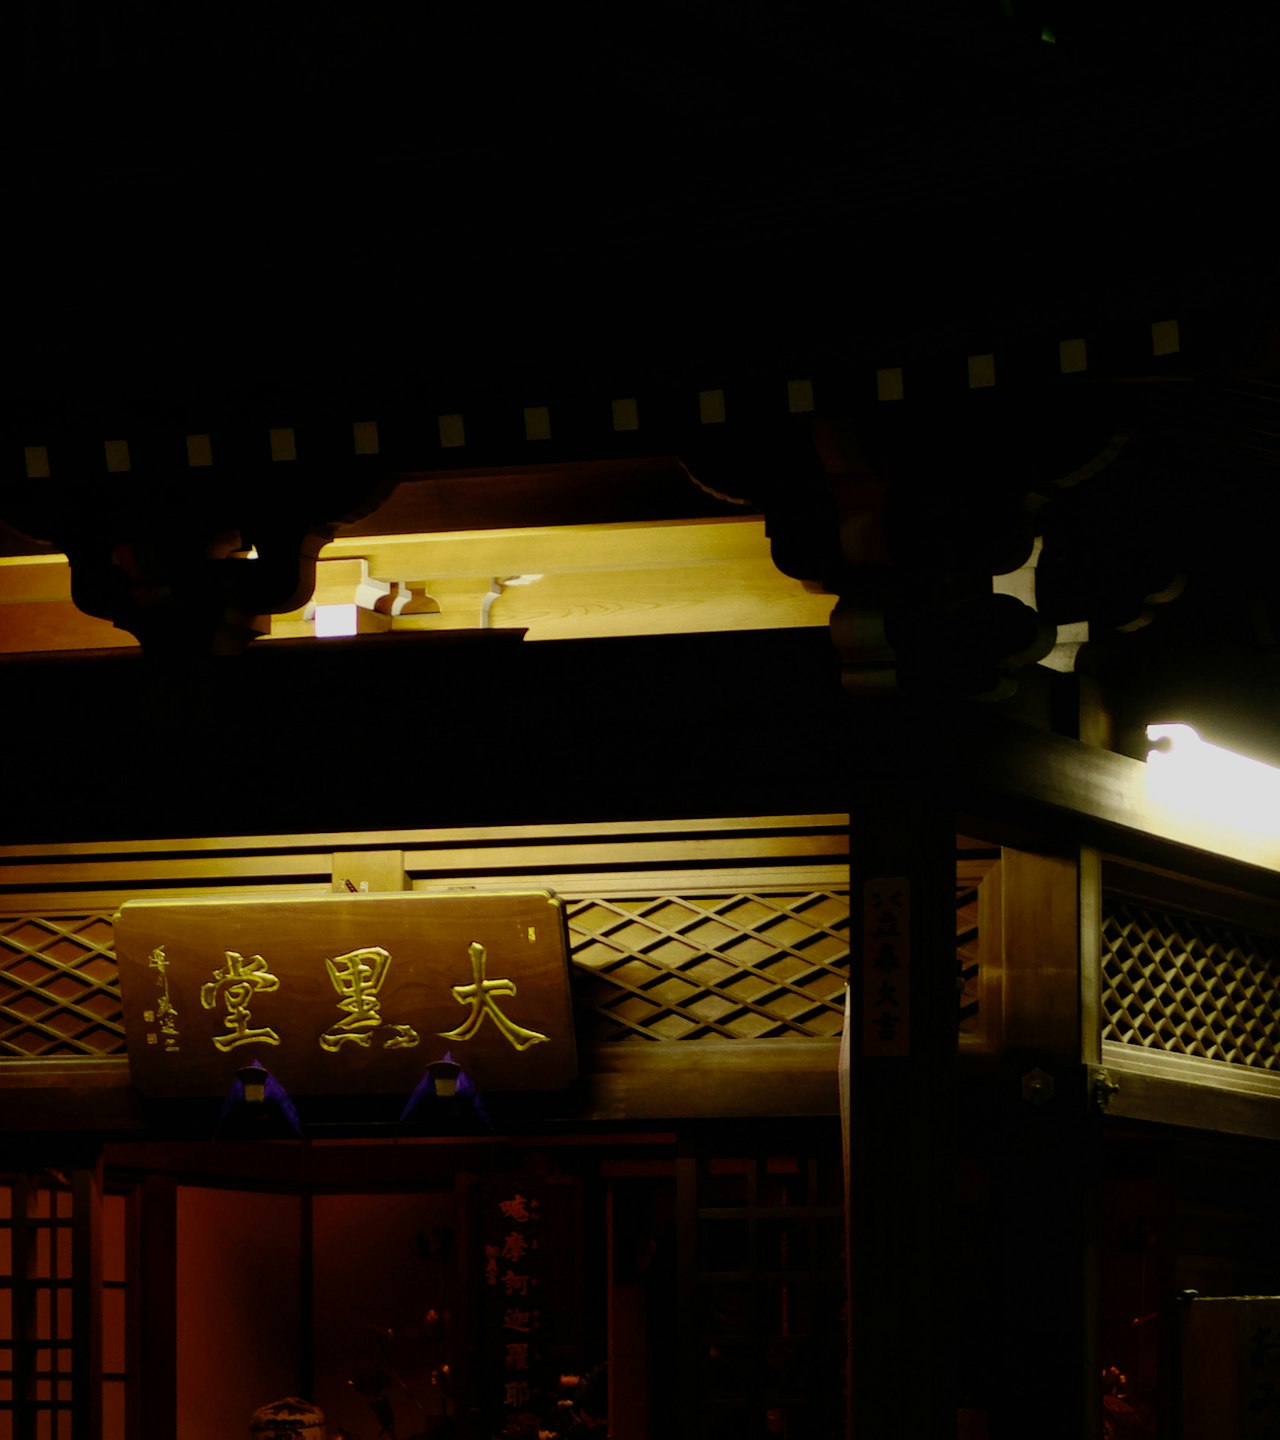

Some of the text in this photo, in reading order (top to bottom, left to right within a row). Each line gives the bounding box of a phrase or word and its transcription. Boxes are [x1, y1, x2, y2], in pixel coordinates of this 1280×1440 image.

[200, 940, 552, 1054] 大黒堂
[871, 909, 903, 1041] 立春大吉
